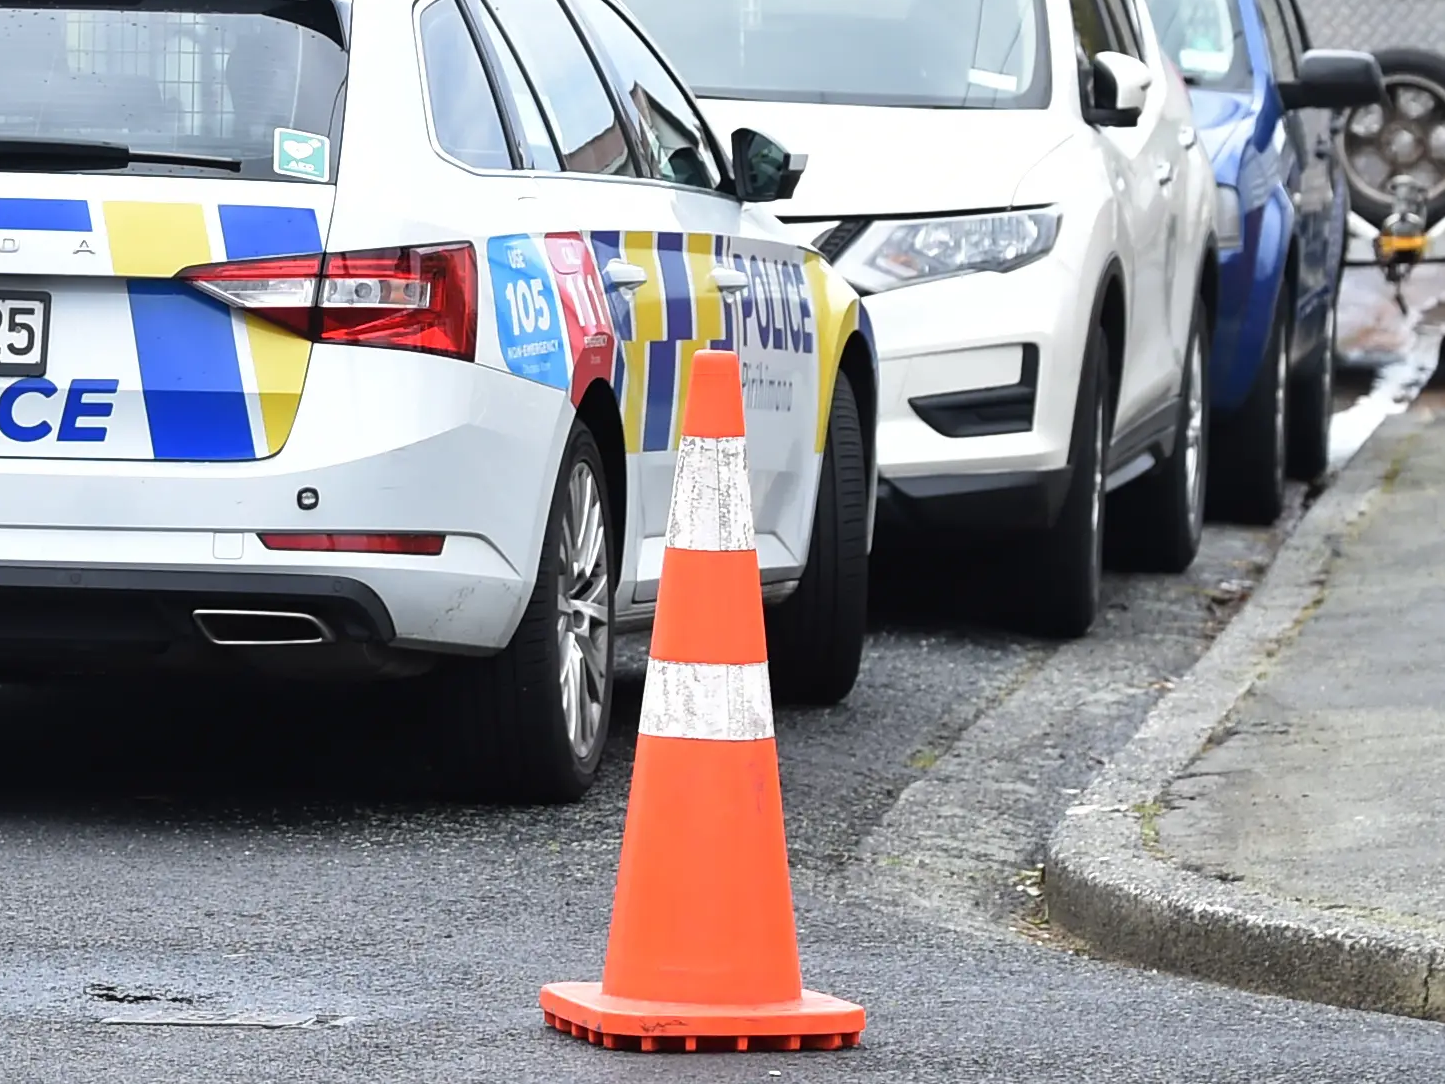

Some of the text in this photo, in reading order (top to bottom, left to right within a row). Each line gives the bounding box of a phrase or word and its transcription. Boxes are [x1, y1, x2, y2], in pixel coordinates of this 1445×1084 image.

[507, 248, 525, 268] USE
[505, 279, 550, 336] 105
[565, 274, 606, 326] 111
[733, 253, 813, 354] POLICE
[507, 339, 559, 359] NON-EMERGENCY
